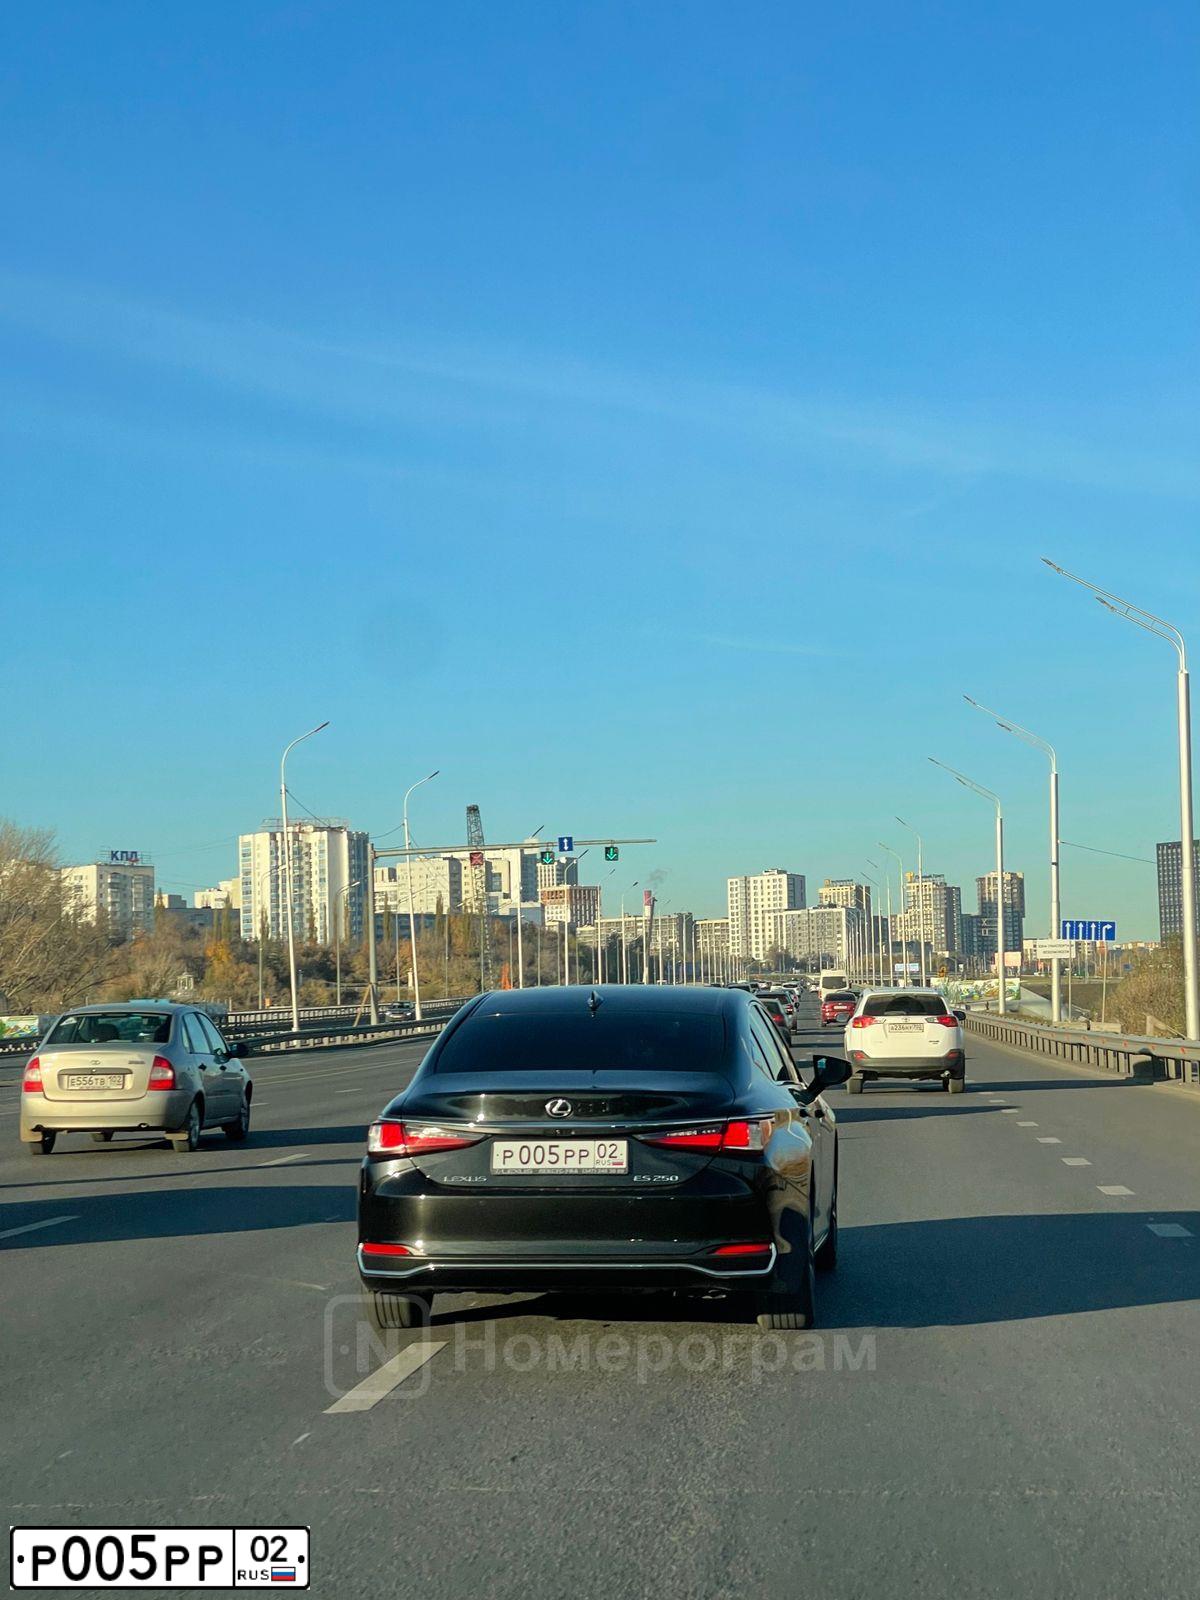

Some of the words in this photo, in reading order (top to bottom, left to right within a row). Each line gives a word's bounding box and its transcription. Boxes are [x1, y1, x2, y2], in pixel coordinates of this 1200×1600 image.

[111, 851, 139, 862] КПД
[71, 1076, 105, 1086] Е556ТВ
[108, 1075, 122, 1083] 102
[502, 1145, 589, 1165] Р005РР
[597, 1143, 618, 1159] 02
